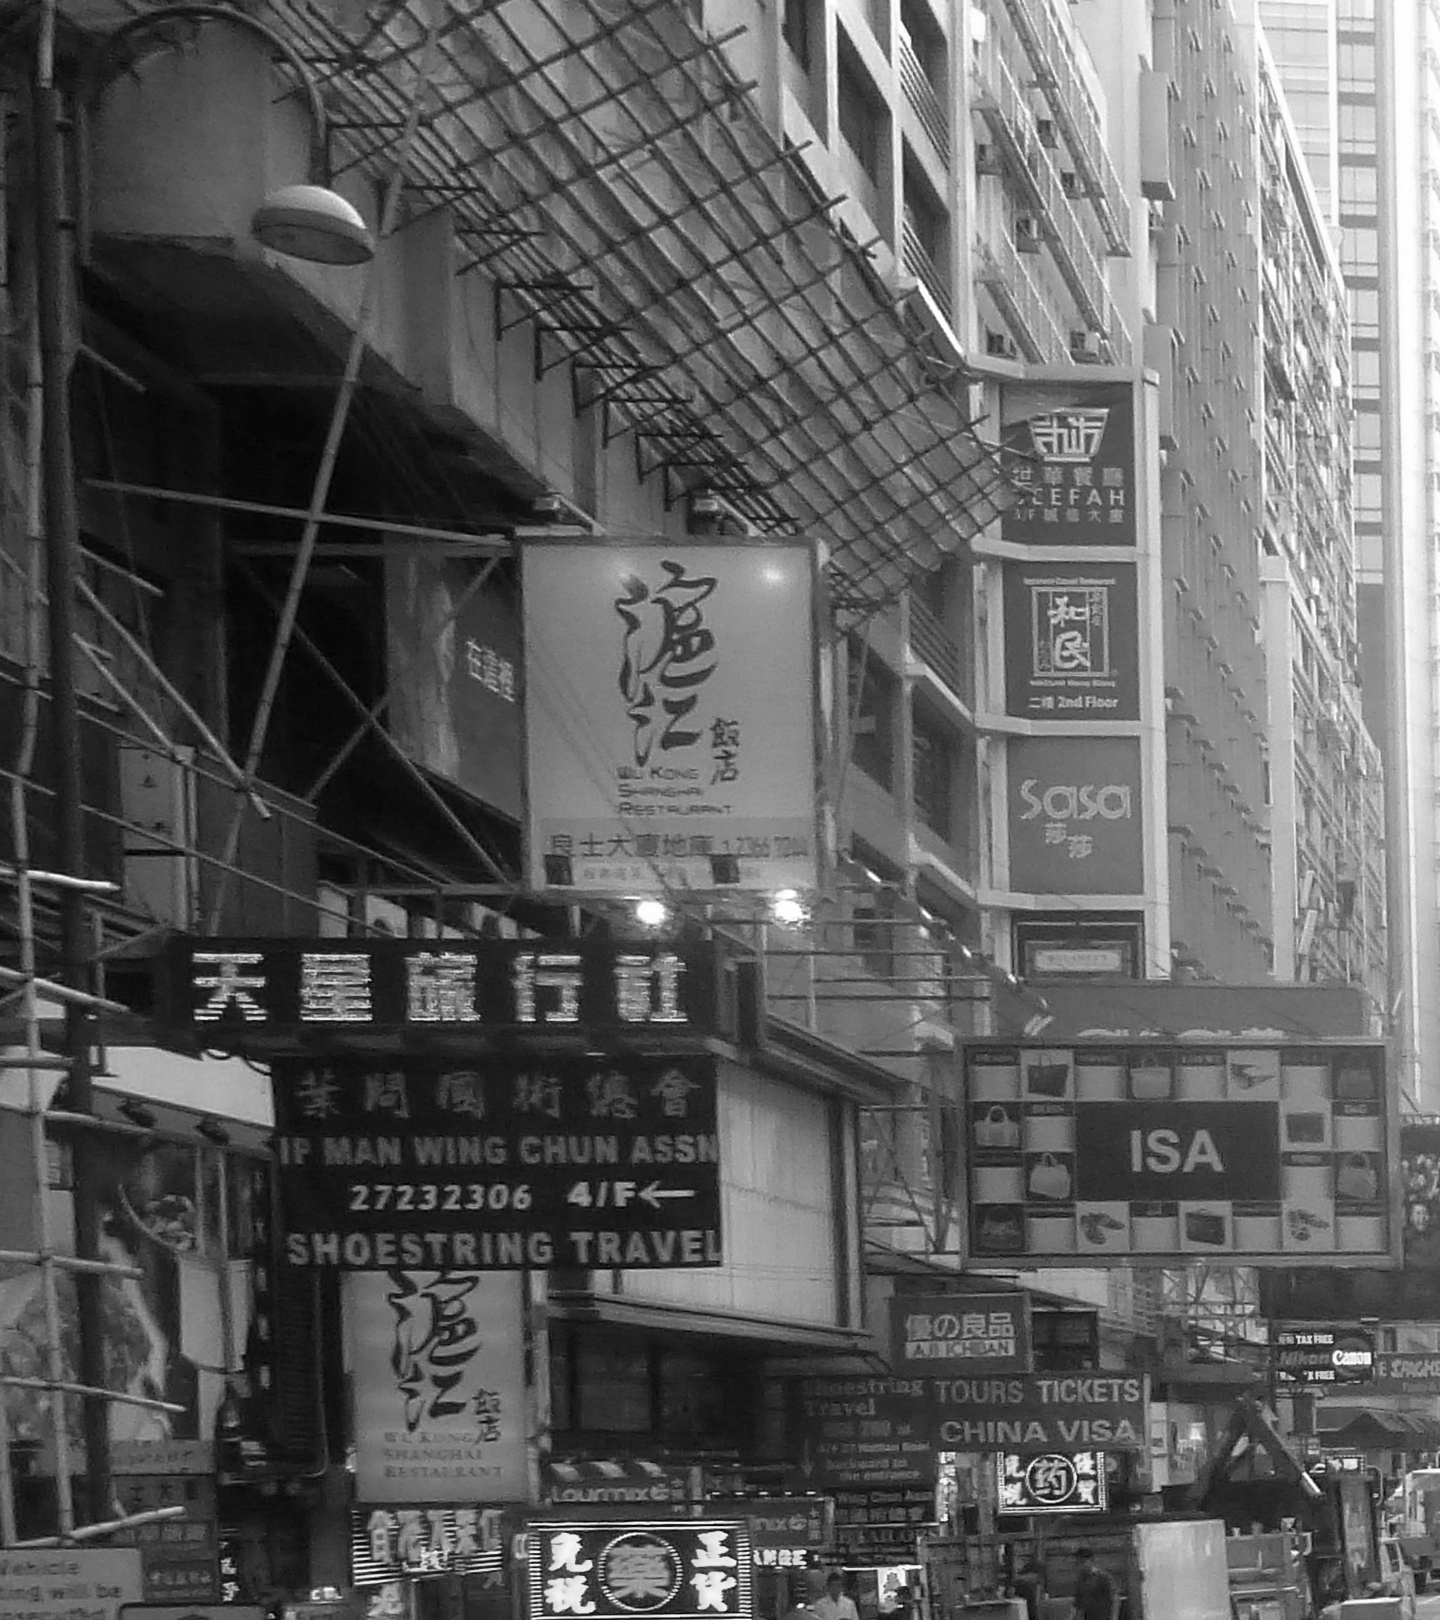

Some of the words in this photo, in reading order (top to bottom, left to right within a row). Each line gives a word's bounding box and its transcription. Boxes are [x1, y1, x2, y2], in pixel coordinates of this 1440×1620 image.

[279, 1135, 310, 1166] IP
[323, 1135, 402, 1166] MAN
[414, 1135, 508, 1166] WING
[519, 1135, 620, 1165] CHUN
[631, 1134, 719, 1164] ASSN
[1130, 1128, 1225, 1174] ISA
[349, 1184, 533, 1211] 27232306
[566, 1181, 637, 1209] 4/F
[287, 1230, 554, 1266] SHOESTRING
[567, 1228, 722, 1265] TRAVEL
[1314, 1333, 1335, 1345] FREE
[1331, 1350, 1372, 1367] Canon
[934, 1379, 1024, 1404] TOURS
[1036, 1378, 1141, 1404] TICKETS
[940, 1420, 1048, 1444] CHINA
[1056, 1419, 1139, 1444] VISA
